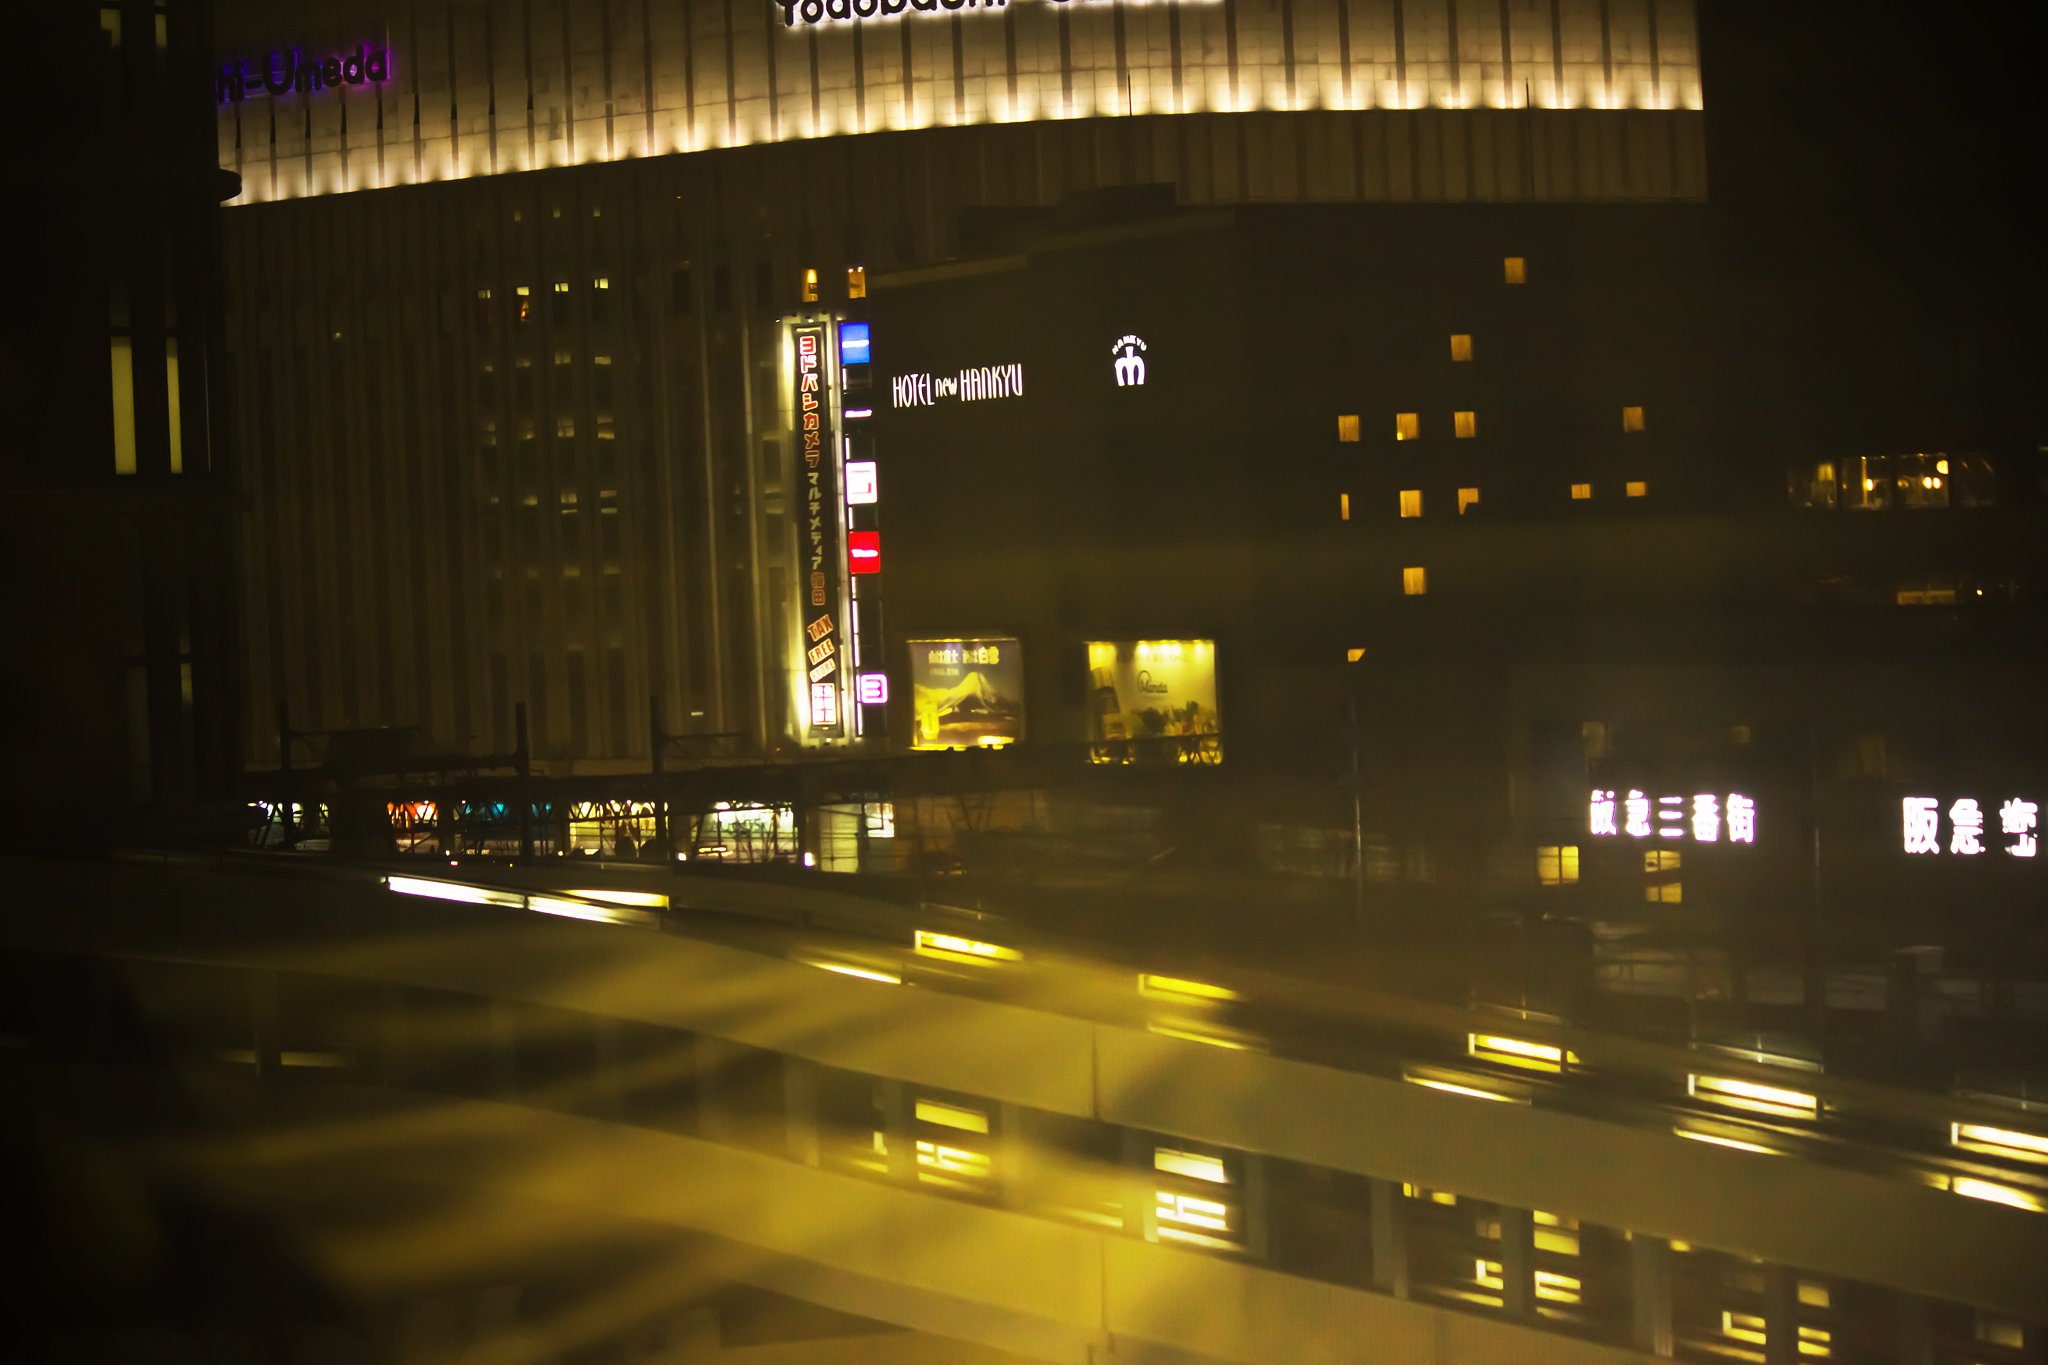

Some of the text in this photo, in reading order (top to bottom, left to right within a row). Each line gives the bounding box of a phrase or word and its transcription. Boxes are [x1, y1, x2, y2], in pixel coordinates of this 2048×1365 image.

[800, 335, 820, 468] ヨドバシカメラ
[892, 363, 1023, 408] HOTEL new HANKYU
[807, 614, 834, 642] TAX
[807, 638, 835, 665] FREE
